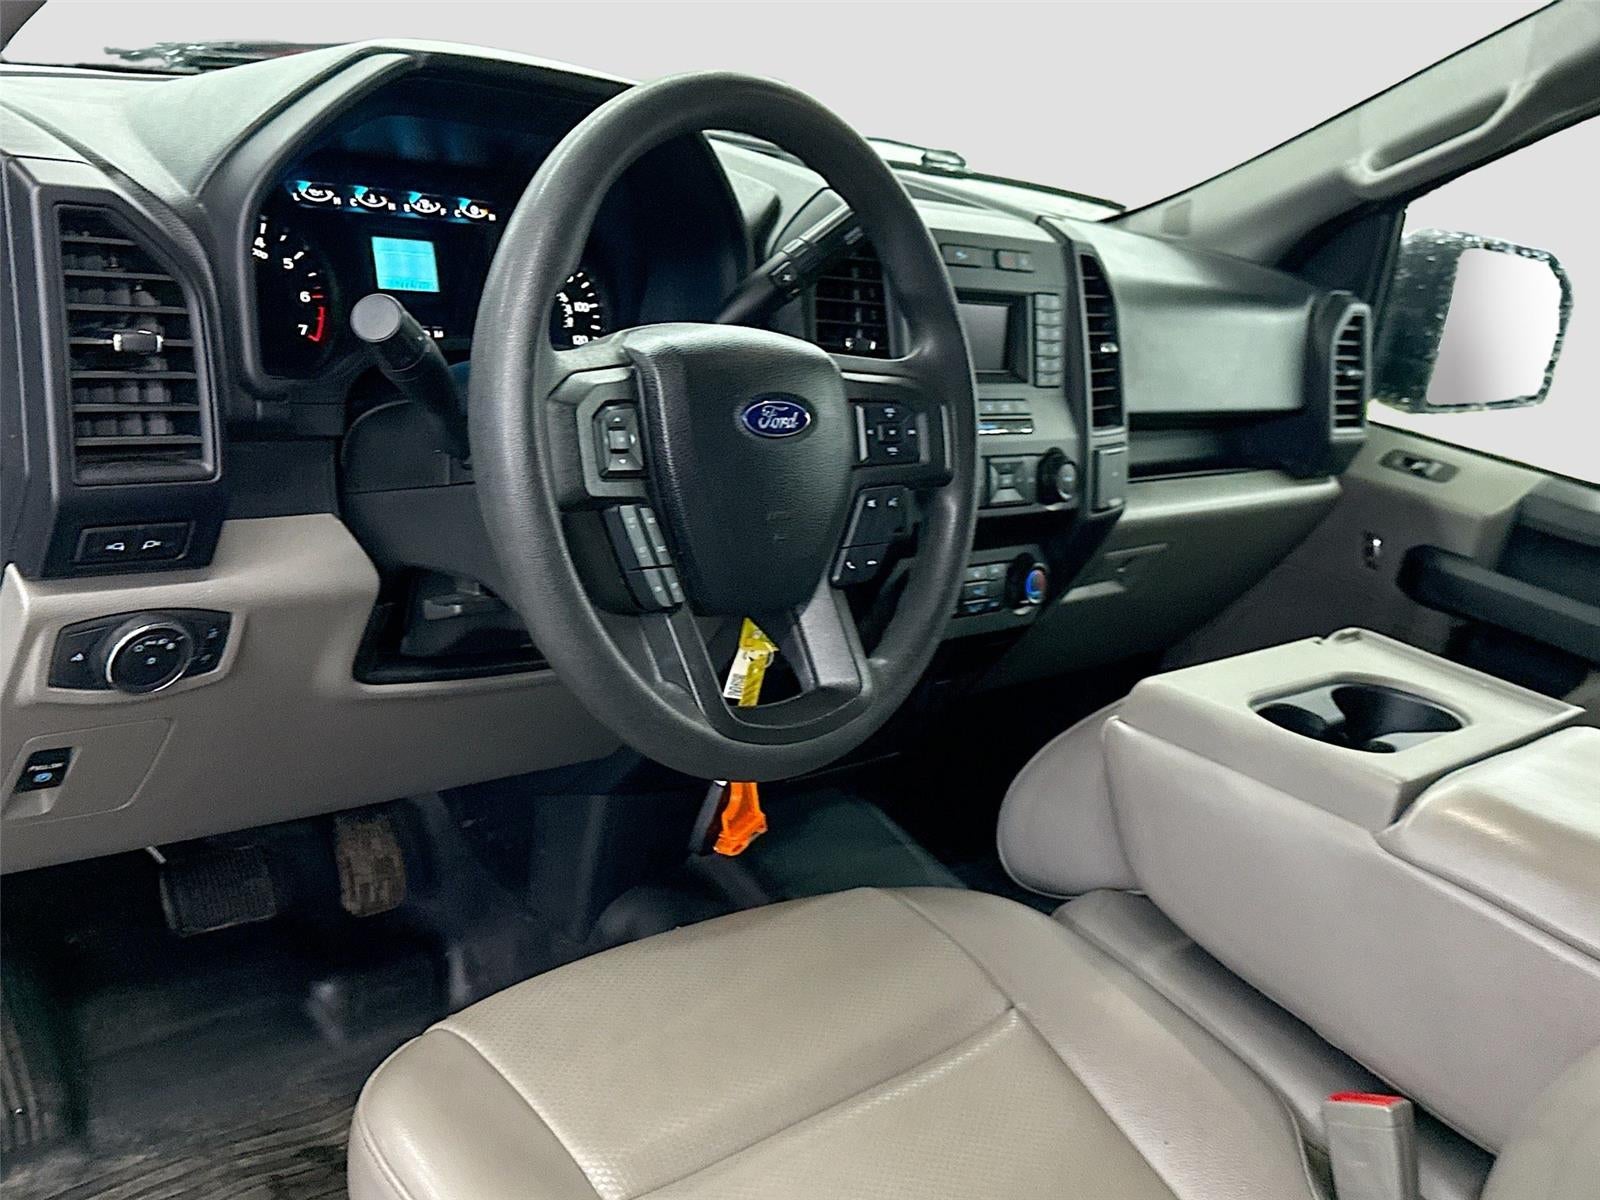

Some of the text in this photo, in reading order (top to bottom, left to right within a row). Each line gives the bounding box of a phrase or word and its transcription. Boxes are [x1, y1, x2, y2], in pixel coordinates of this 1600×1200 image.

[282, 257, 294, 270] 5
[299, 290, 311, 303] 6
[297, 323, 309, 336] 7
[758, 404, 799, 429] Ford
